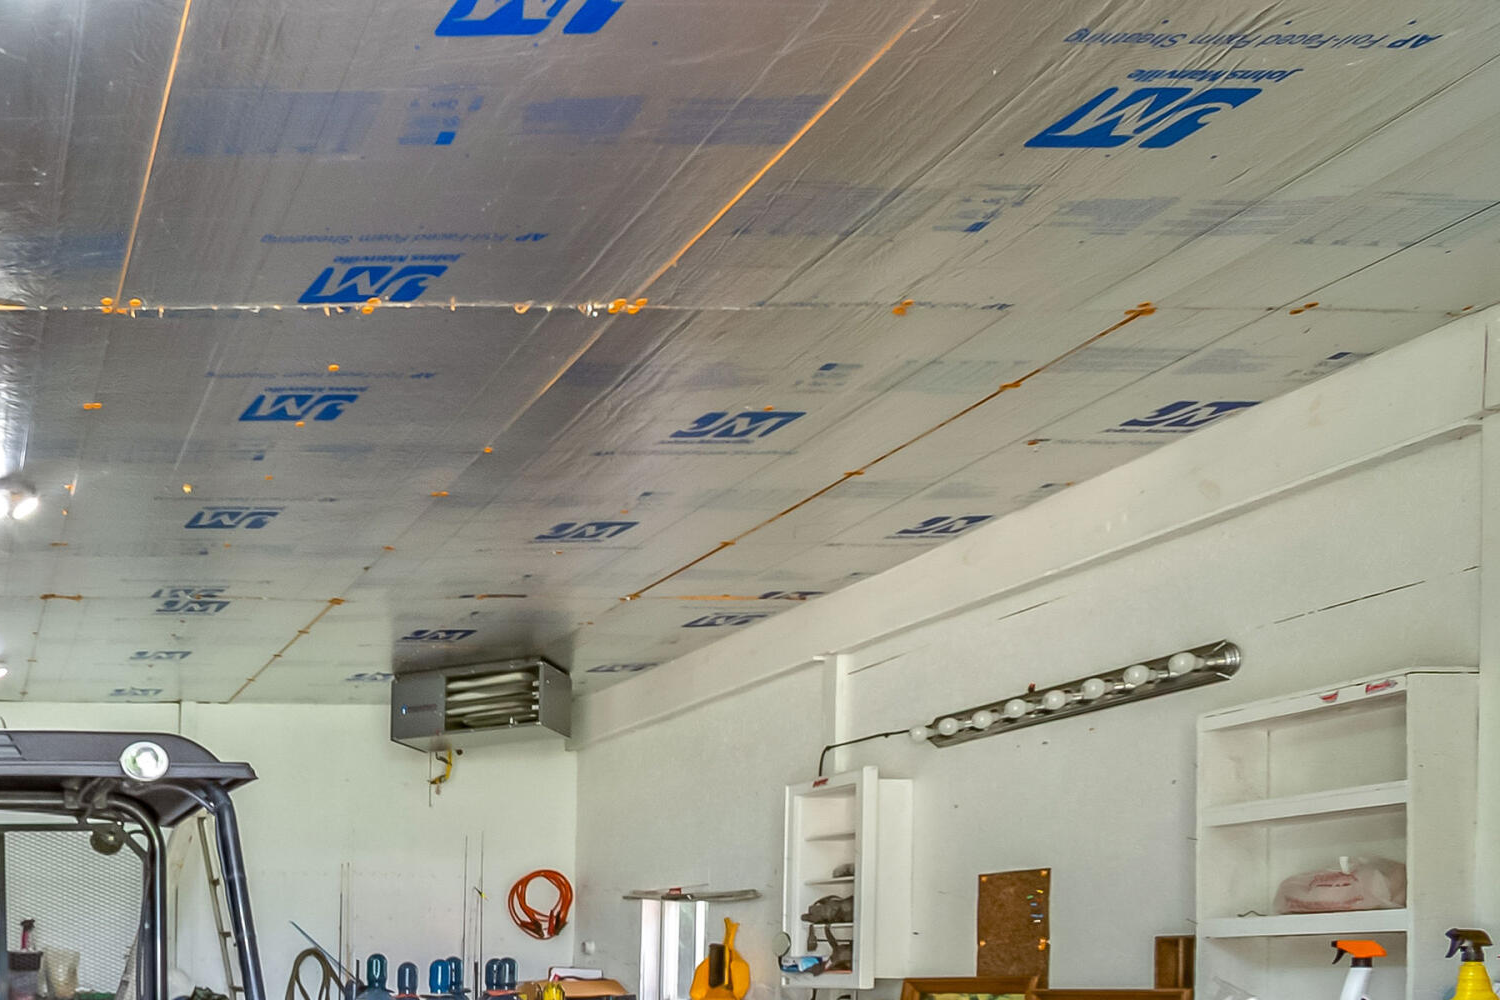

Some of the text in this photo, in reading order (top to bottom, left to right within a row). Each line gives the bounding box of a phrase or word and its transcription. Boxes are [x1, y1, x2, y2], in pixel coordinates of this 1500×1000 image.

[1062, 28, 1188, 49] Sheathing
[1260, 33, 1389, 49] Foil-Faced
[1386, 34, 1443, 49] AP
[1024, 87, 1262, 148] JM
[515, 233, 549, 242] AP
[298, 265, 448, 303] JM
[239, 394, 358, 421] JM
[671, 411, 805, 438] JM
[185, 507, 281, 529] JM
[896, 515, 993, 536] JM
[535, 521, 639, 541] JM
